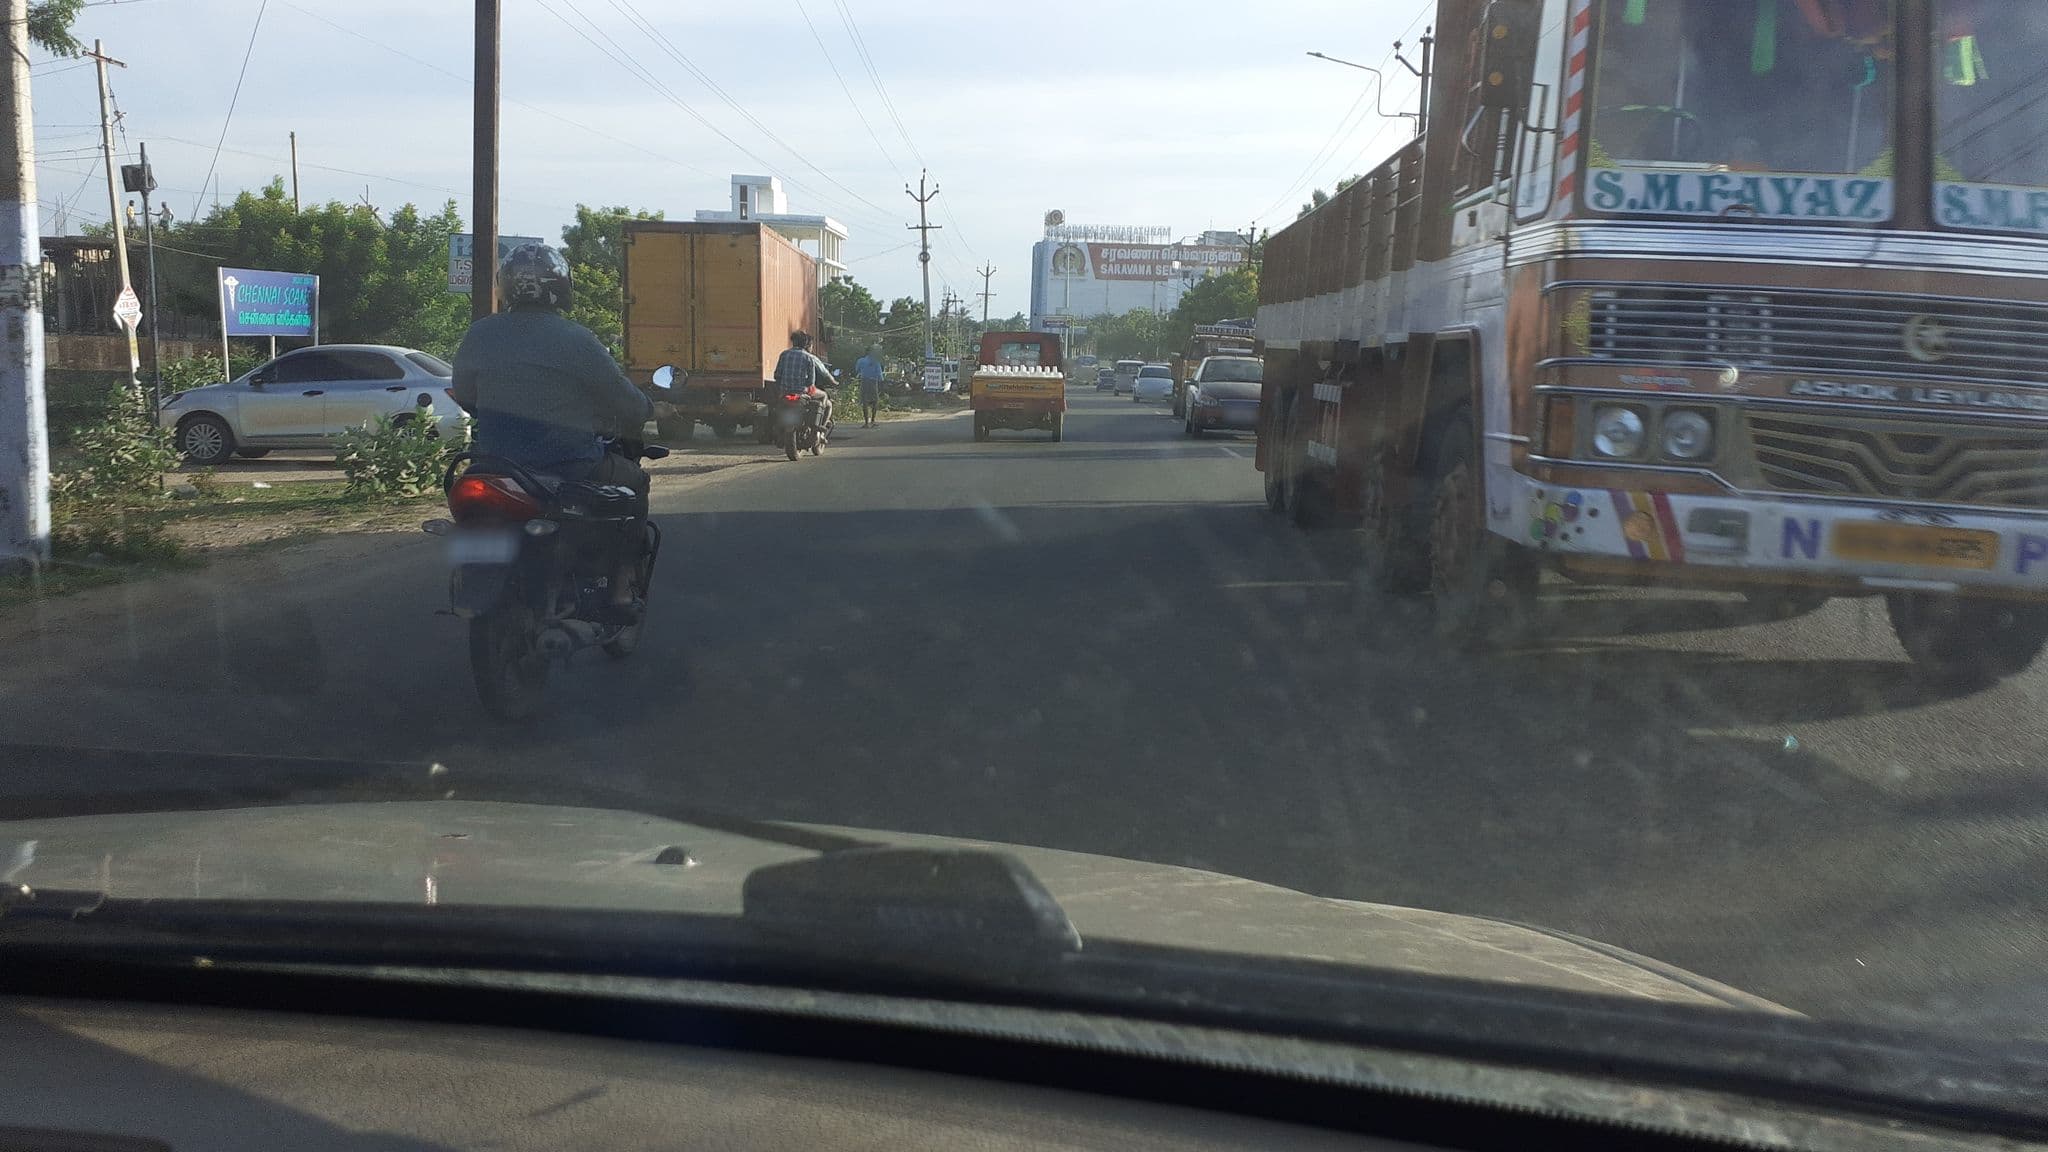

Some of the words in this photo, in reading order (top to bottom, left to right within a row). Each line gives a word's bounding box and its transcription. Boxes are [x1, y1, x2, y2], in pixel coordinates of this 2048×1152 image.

[1594, 171, 1883, 217] S.M.FAYAZ
[1101, 264, 1152, 276] SARAVANA
[238, 284, 281, 305] CHENNAI
[1789, 380, 1898, 400] ASHOK
[1781, 516, 1821, 560] N
